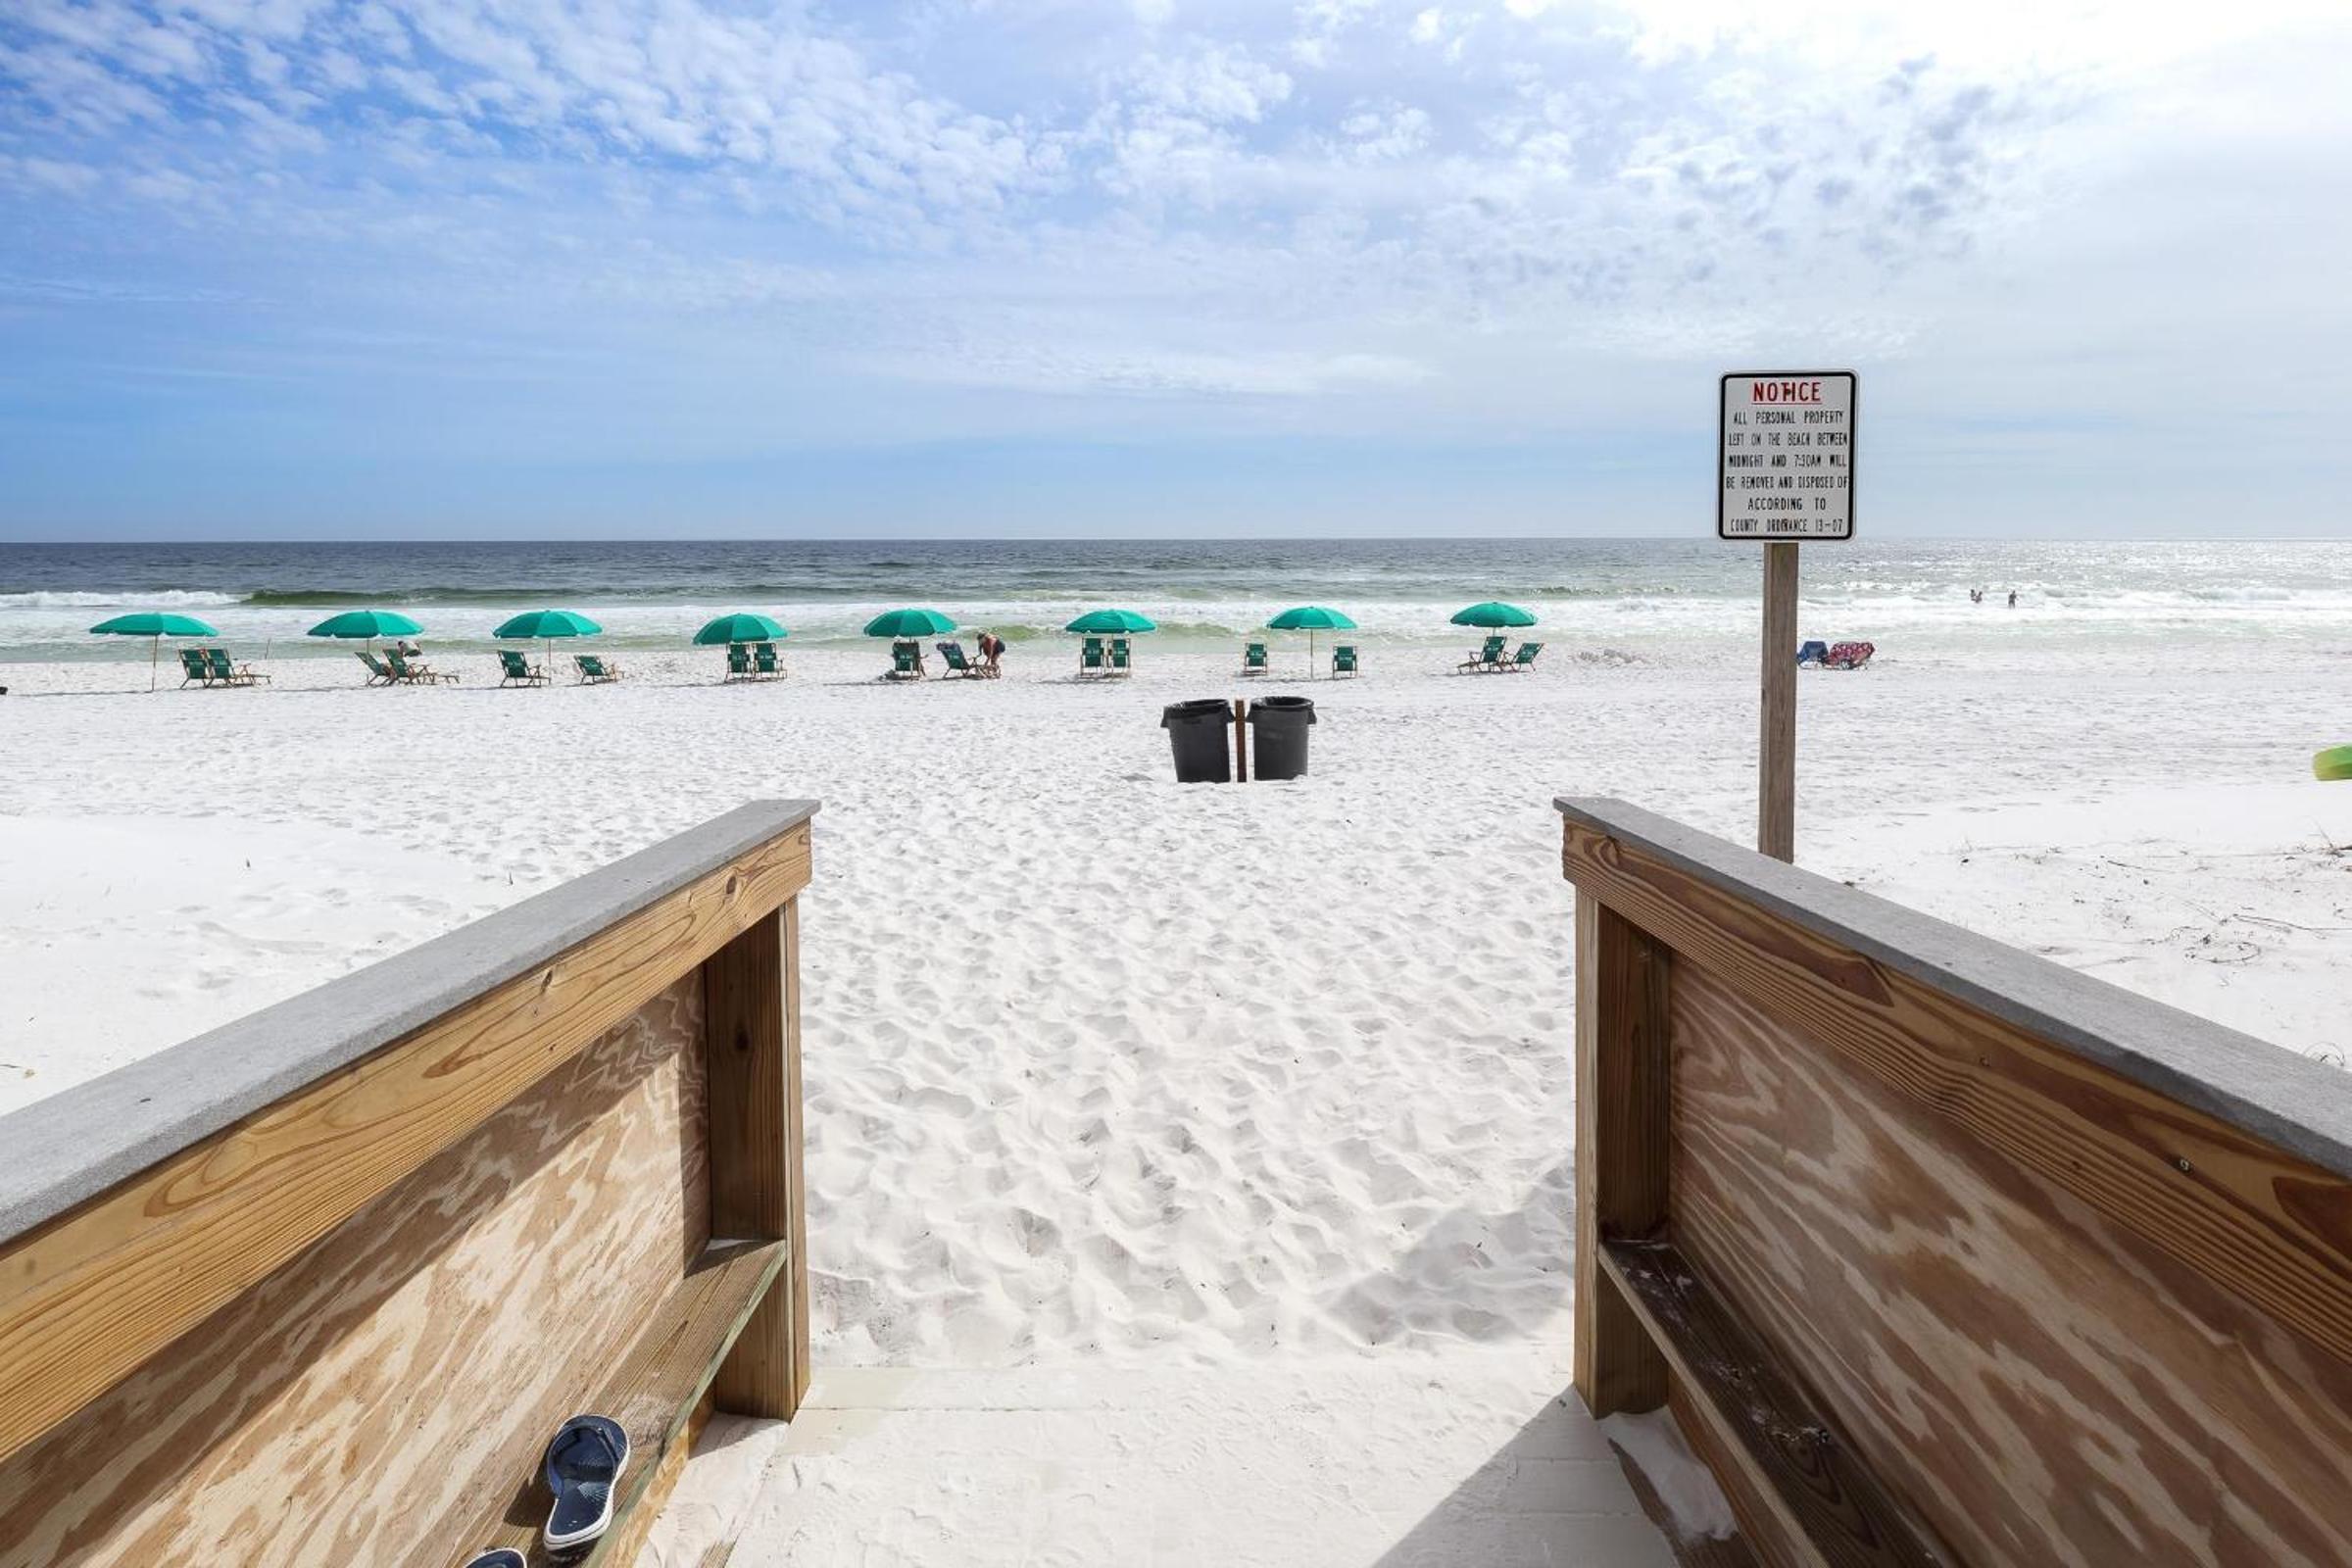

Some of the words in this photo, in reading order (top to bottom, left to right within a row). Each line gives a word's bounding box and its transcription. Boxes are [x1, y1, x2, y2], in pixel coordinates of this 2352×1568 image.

[1754, 382, 1821, 402] NOTICE
[1734, 412, 1747, 424] ALL
[1756, 412, 1795, 424] PERSONAL
[1804, 411, 1844, 423] PROPERTY
[1729, 433, 1744, 446] LEFT
[1751, 433, 1761, 446] ON
[1769, 432, 1781, 446] THE
[1788, 432, 1810, 446] BEACH
[1818, 432, 1847, 446] BETWEEN
[1729, 455, 1763, 467] MIDNIGHT
[1772, 455, 1787, 467] AND
[1830, 455, 1846, 466] WILL
[1726, 476, 1735, 489] BE
[1741, 476, 1774, 489] REMOVED
[1779, 476, 1792, 489] AND
[1798, 476, 1834, 488] DISPOSED
[1838, 476, 1848, 488] OF
[1748, 498, 1802, 511] ACCORDING
[1815, 498, 1826, 511] TO
[1731, 519, 1758, 532] COUNTY
